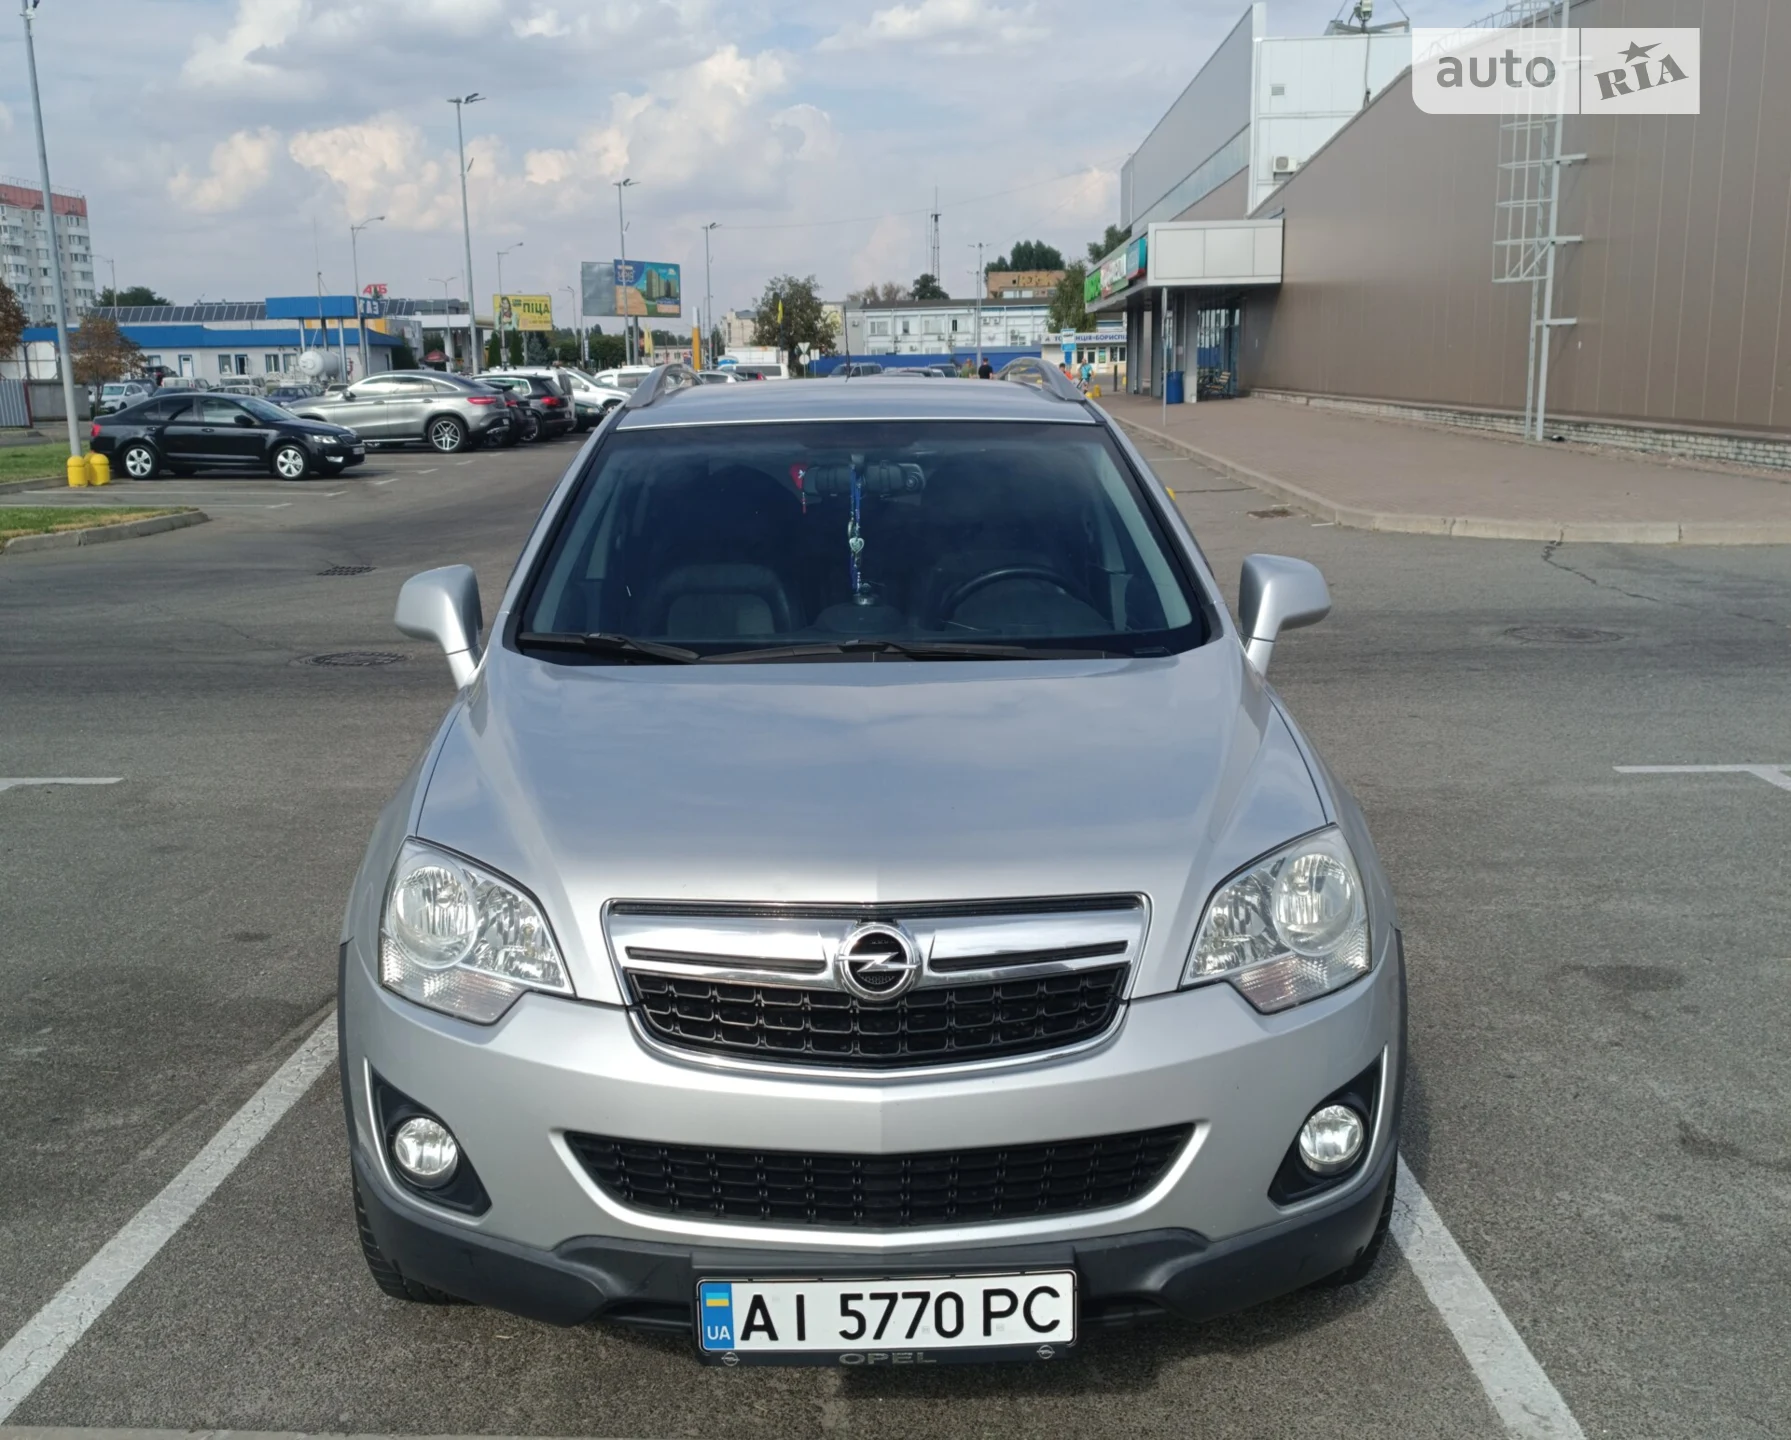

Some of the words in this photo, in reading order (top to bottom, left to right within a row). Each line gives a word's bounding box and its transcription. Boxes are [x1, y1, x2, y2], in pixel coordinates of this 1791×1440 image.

[522, 302, 550, 316] ПІЦА
[740, 1294, 806, 1341] AI
[839, 1291, 964, 1341] 5770
[983, 1285, 1061, 1337] PC
[707, 1325, 731, 1341] UA
[839, 1352, 937, 1365] OPEL
